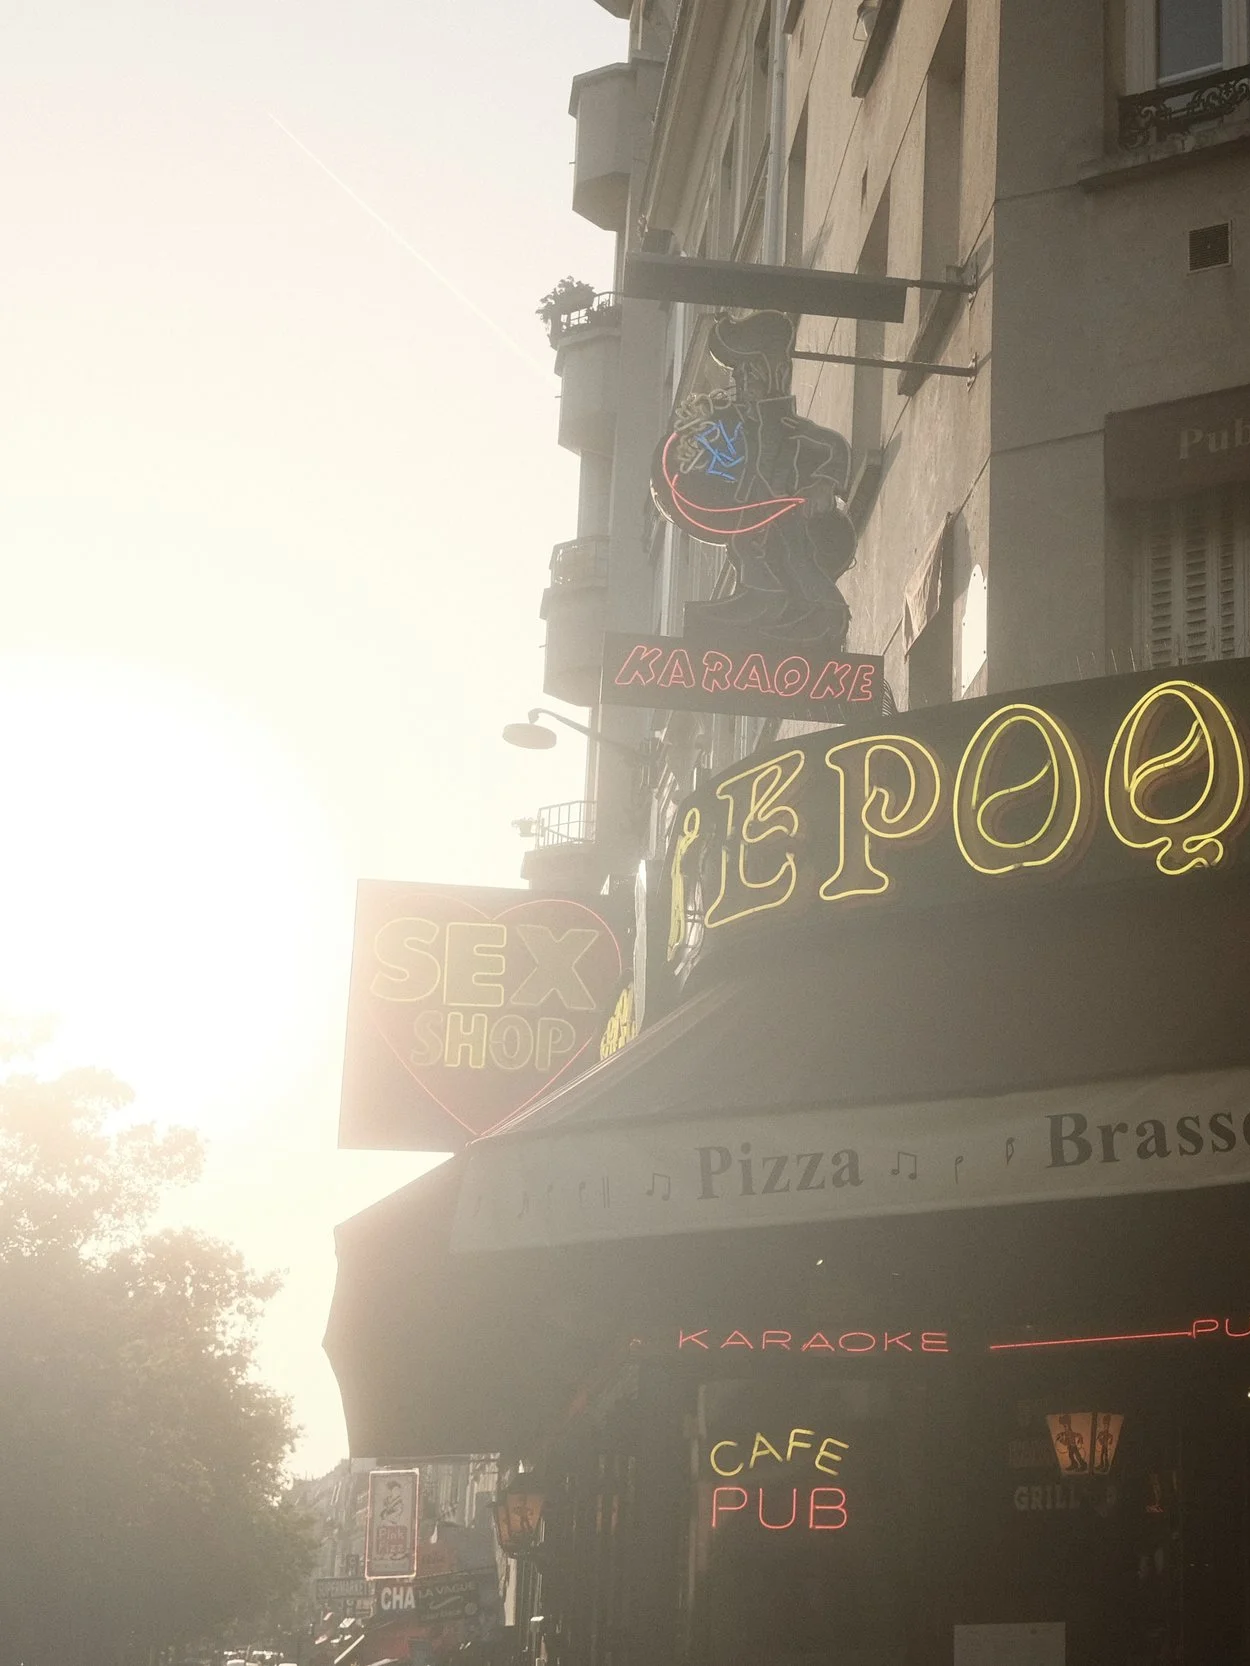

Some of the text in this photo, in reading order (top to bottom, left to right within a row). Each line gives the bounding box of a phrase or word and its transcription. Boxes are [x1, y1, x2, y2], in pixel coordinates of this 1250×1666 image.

[615, 644, 877, 703] KARAOKE
[369, 915, 600, 1011] SEX
[410, 1009, 577, 1072] SHOP
[697, 1141, 865, 1200] Pizza
[677, 1328, 951, 1353] KARAOKE
[708, 1427, 850, 1477] CAFE
[710, 1485, 849, 1531] PUB
[1013, 1485, 1081, 1512] GRILL
[380, 1586, 417, 1610] CHA
